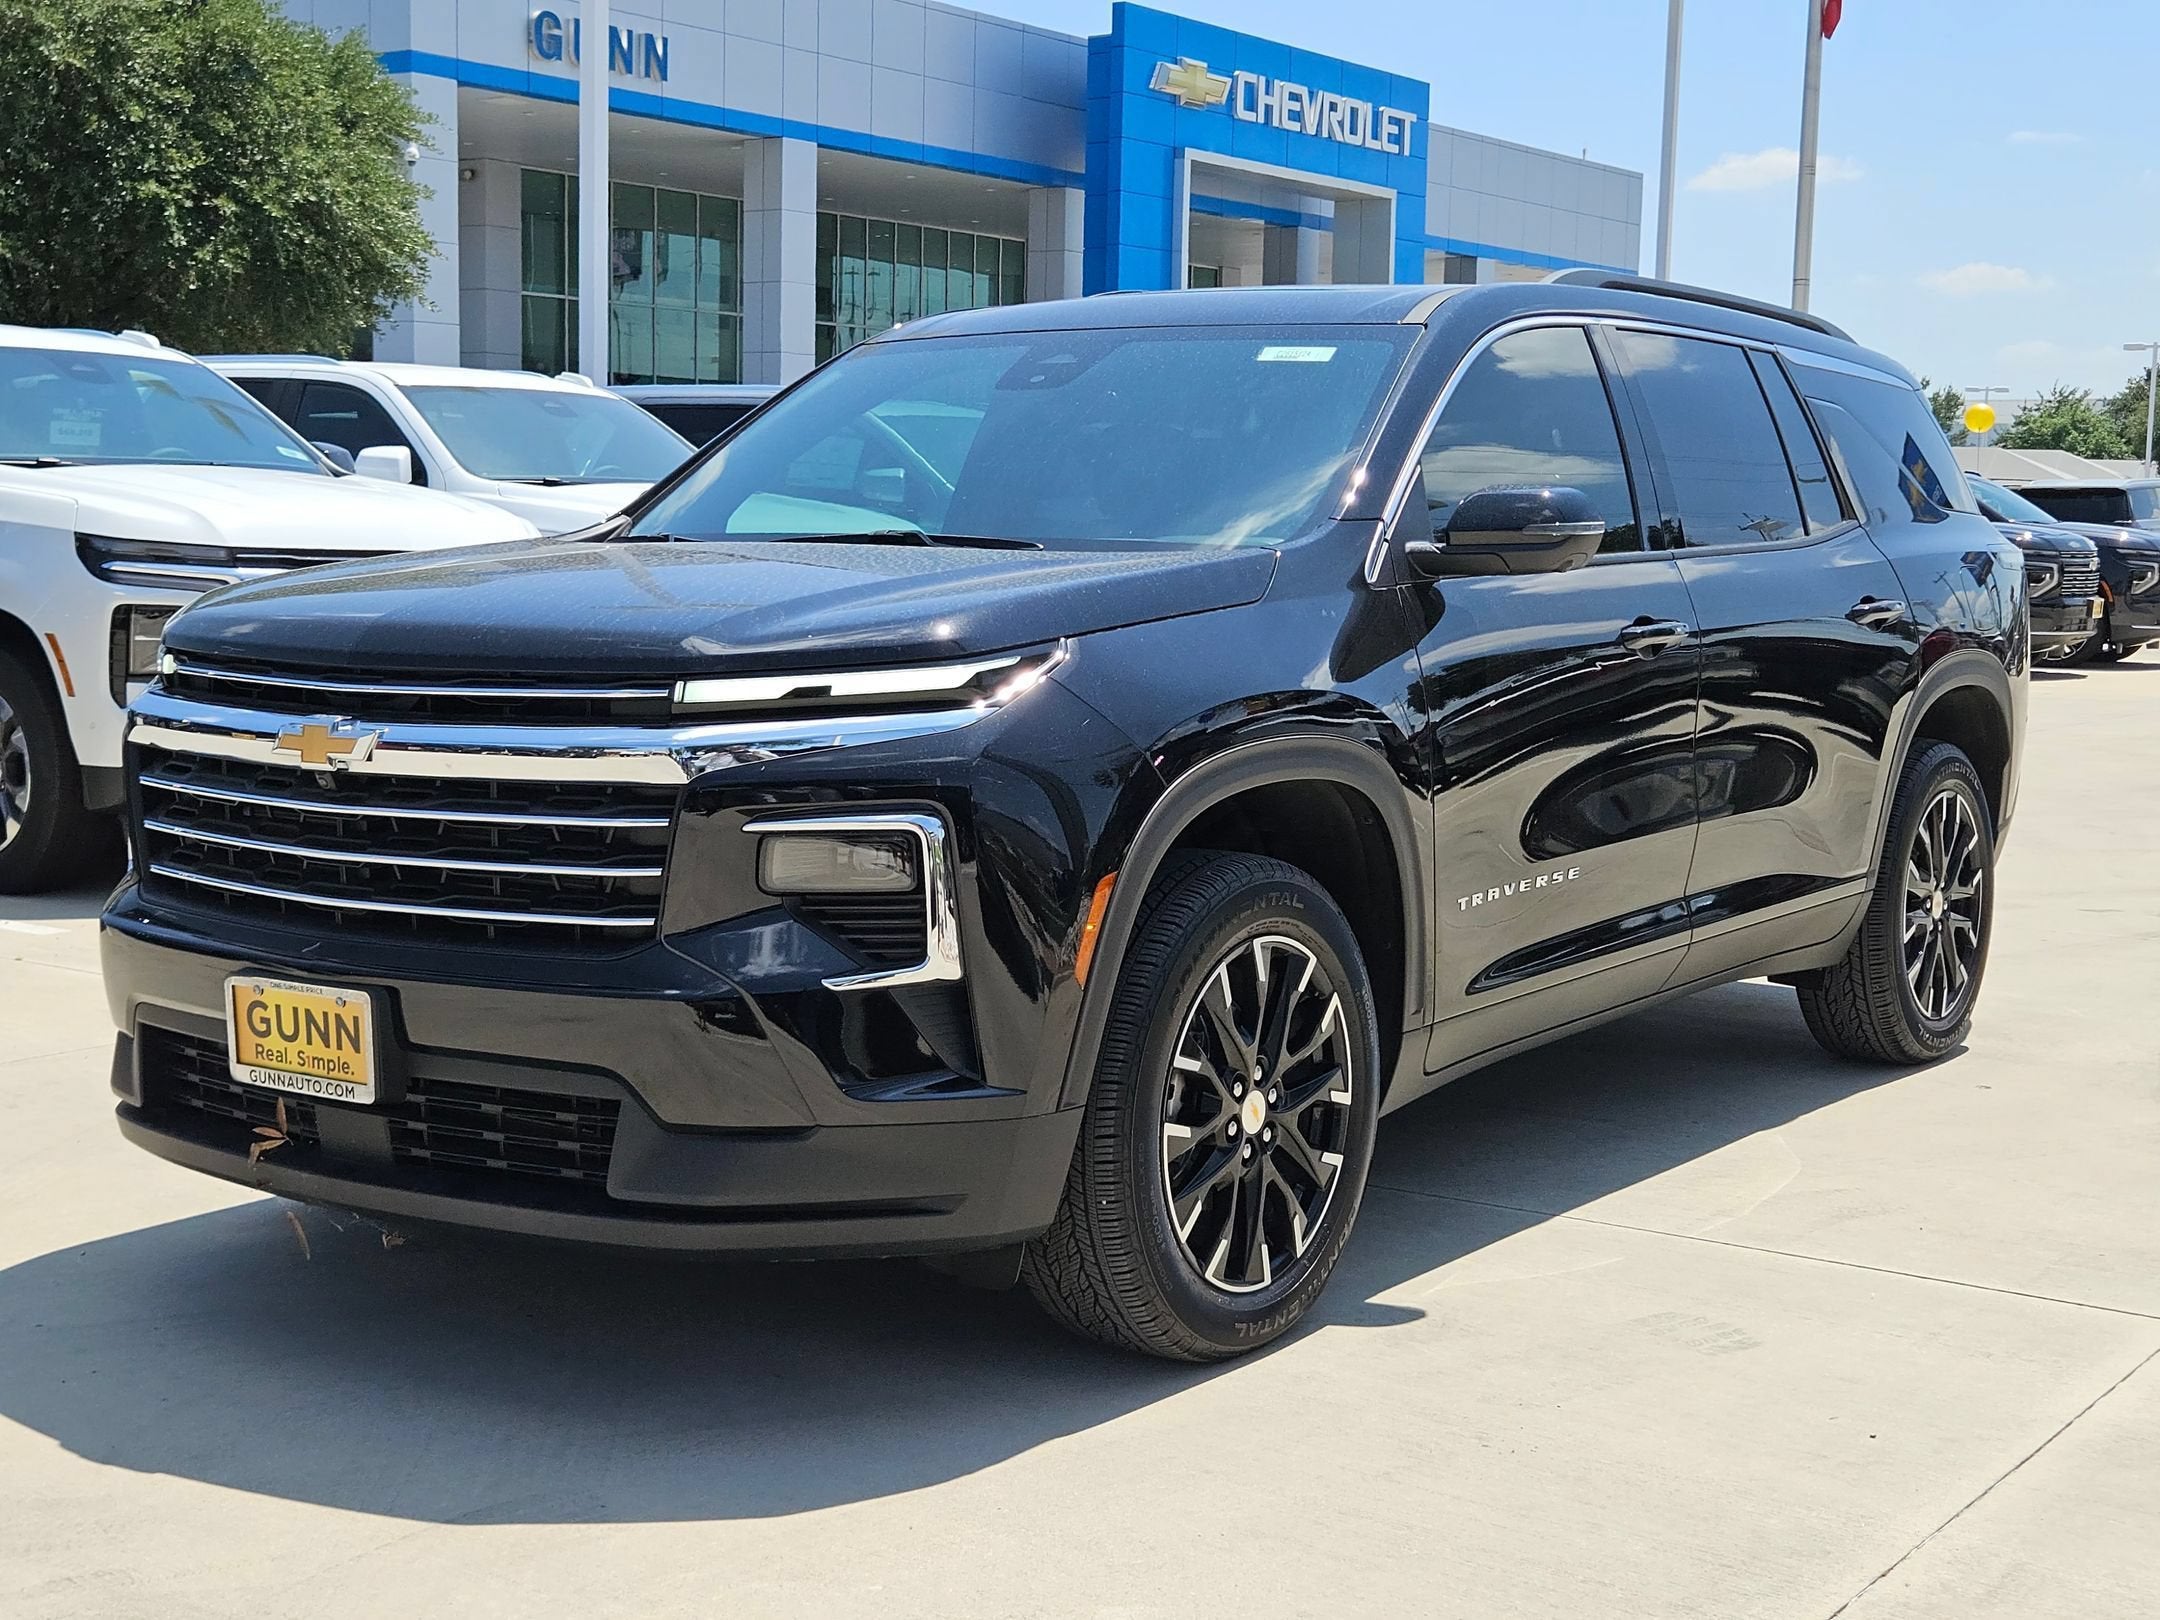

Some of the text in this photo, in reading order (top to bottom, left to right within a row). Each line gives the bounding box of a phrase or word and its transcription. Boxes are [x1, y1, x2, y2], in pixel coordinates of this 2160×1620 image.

[532, 10, 668, 82] GNN
[1234, 70, 1417, 157] CHEVROLET
[1457, 867, 1580, 911] TRAVERSE
[246, 999, 361, 1054] GUNN
[254, 1043, 292, 1065] Real.
[249, 1069, 355, 1099] GUNNAUTO.COM
